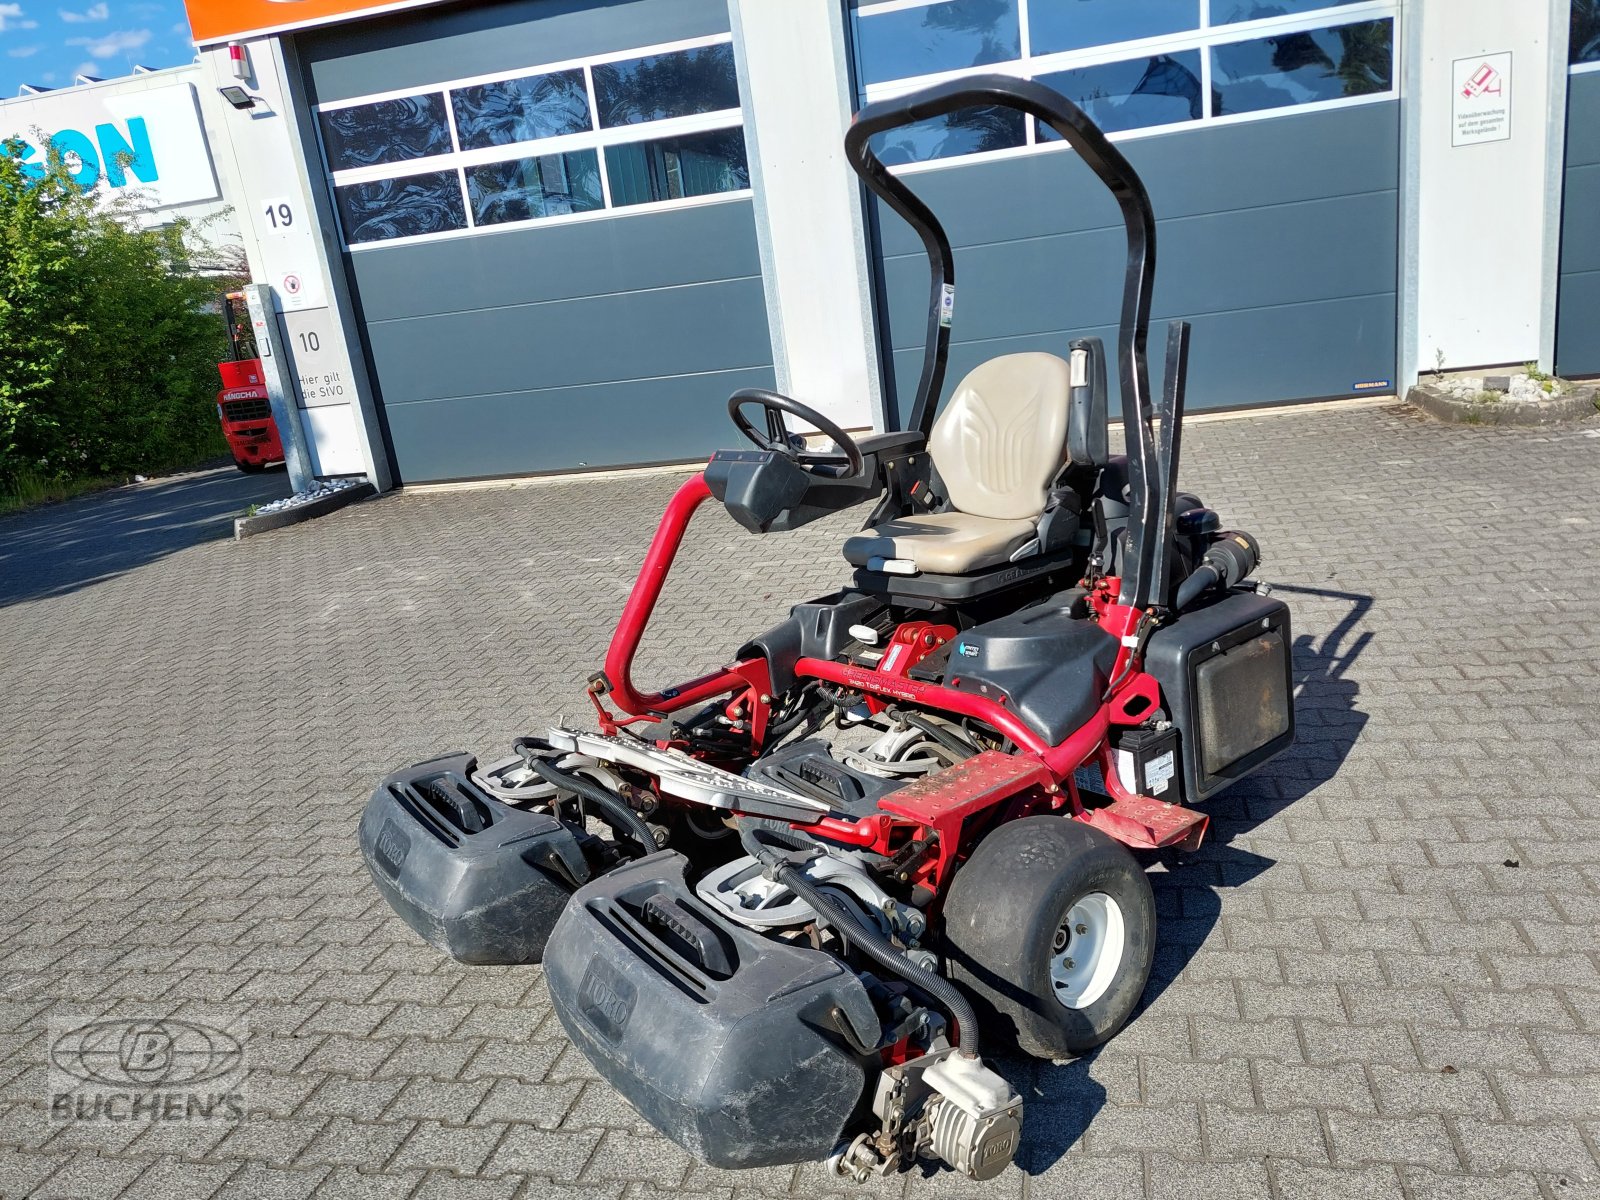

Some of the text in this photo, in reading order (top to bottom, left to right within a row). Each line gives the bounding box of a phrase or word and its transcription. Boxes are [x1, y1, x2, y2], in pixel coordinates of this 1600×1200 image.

[265, 203, 293, 229] 19
[299, 331, 320, 353] 10
[323, 371, 341, 386] gilt
[319, 385, 344, 397] StVO
[586, 971, 628, 1025] TORO
